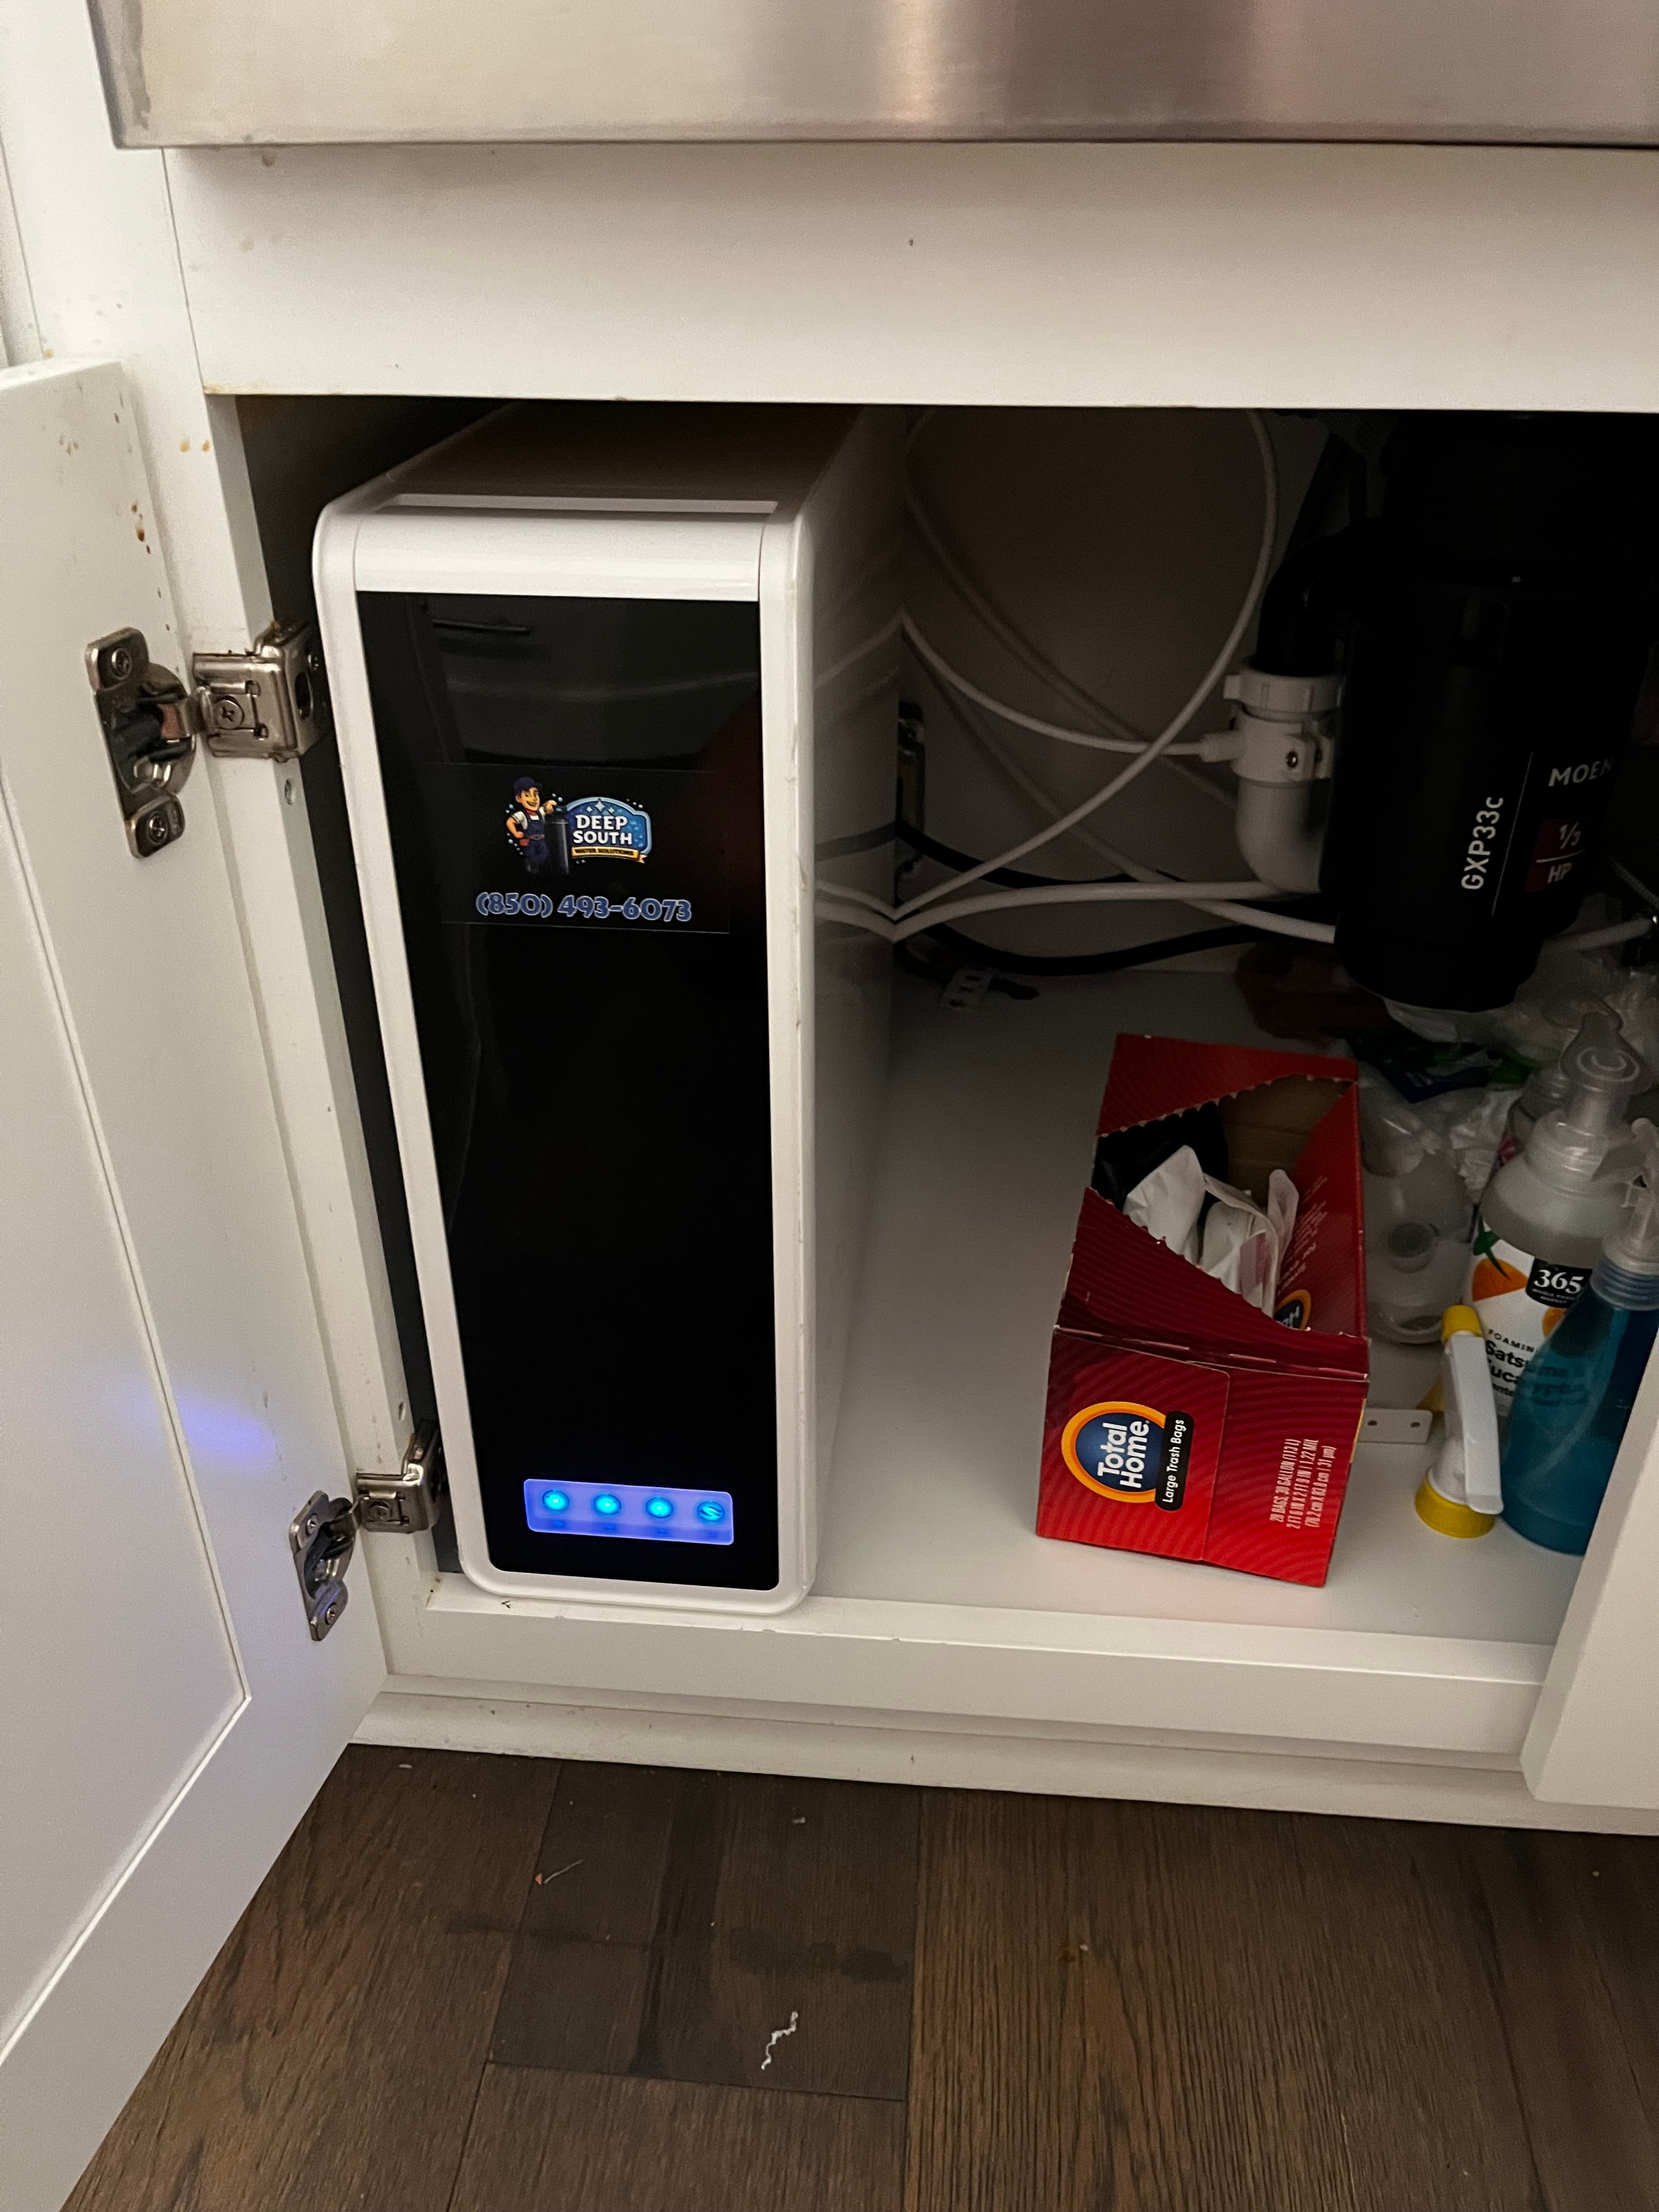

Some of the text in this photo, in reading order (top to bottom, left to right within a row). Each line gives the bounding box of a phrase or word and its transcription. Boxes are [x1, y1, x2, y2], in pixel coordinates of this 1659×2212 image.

[1547, 756, 1615, 787] MOEN
[575, 815, 628, 830] DEEP
[573, 830, 632, 845] SOUTH
[1460, 796, 1504, 890] GXP33c
[1547, 861, 1573, 884] HP
[476, 892, 692, 922] (850) 493-6073
[1534, 1269, 1584, 1294] 365
[1488, 1329, 1535, 1353] FOAMIN
[1097, 1422, 1127, 1476] Total
[1119, 1421, 1149, 1488] Home
[1302, 1439, 1319, 1451] MIL
[1162, 1419, 1187, 1503] Large Trash Bags
[1277, 1460, 1296, 1486] GALLON
[1294, 1483, 1309, 1492] FT
[1287, 1515, 1302, 1524] FT
